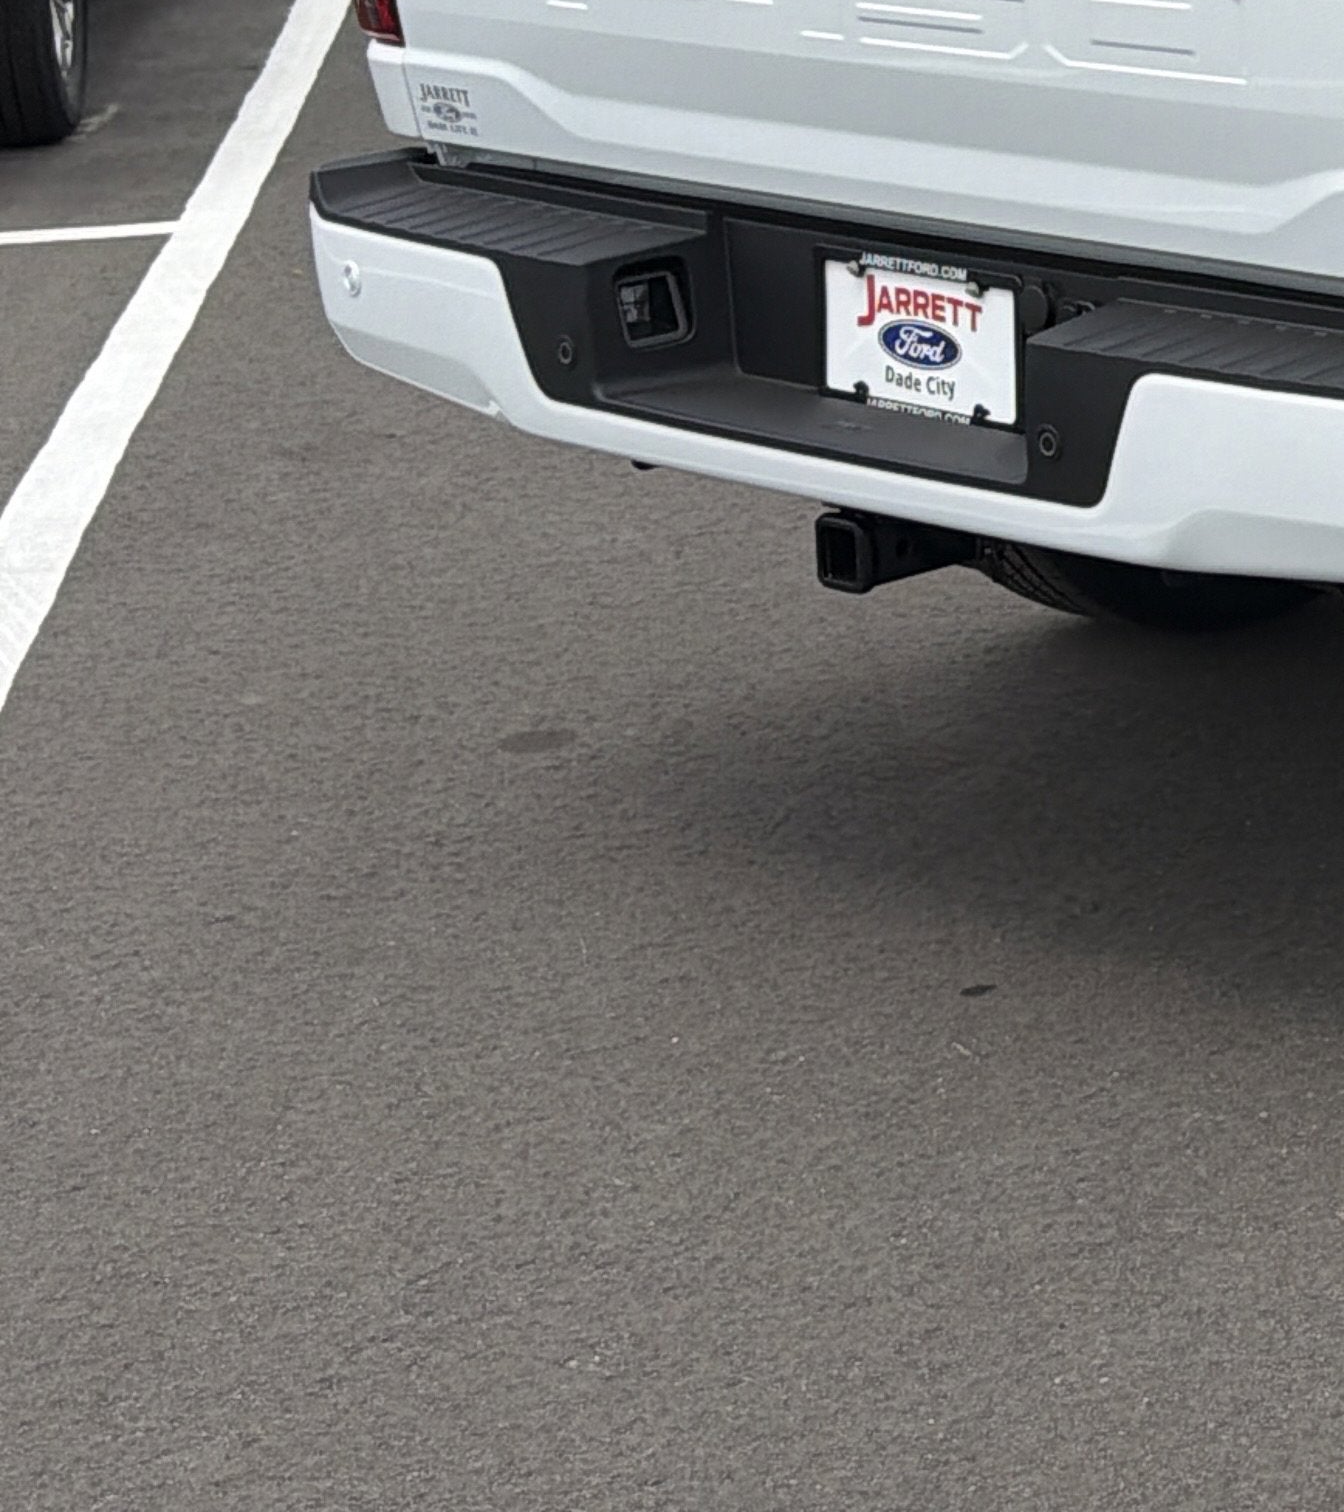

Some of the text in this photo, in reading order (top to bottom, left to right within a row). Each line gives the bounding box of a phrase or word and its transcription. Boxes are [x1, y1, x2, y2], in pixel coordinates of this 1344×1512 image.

[859, 252, 967, 281] JARRETTFORD.COM
[857, 274, 983, 332] JARRETT
[894, 326, 946, 364] Ford
[885, 365, 956, 401] Dade City
